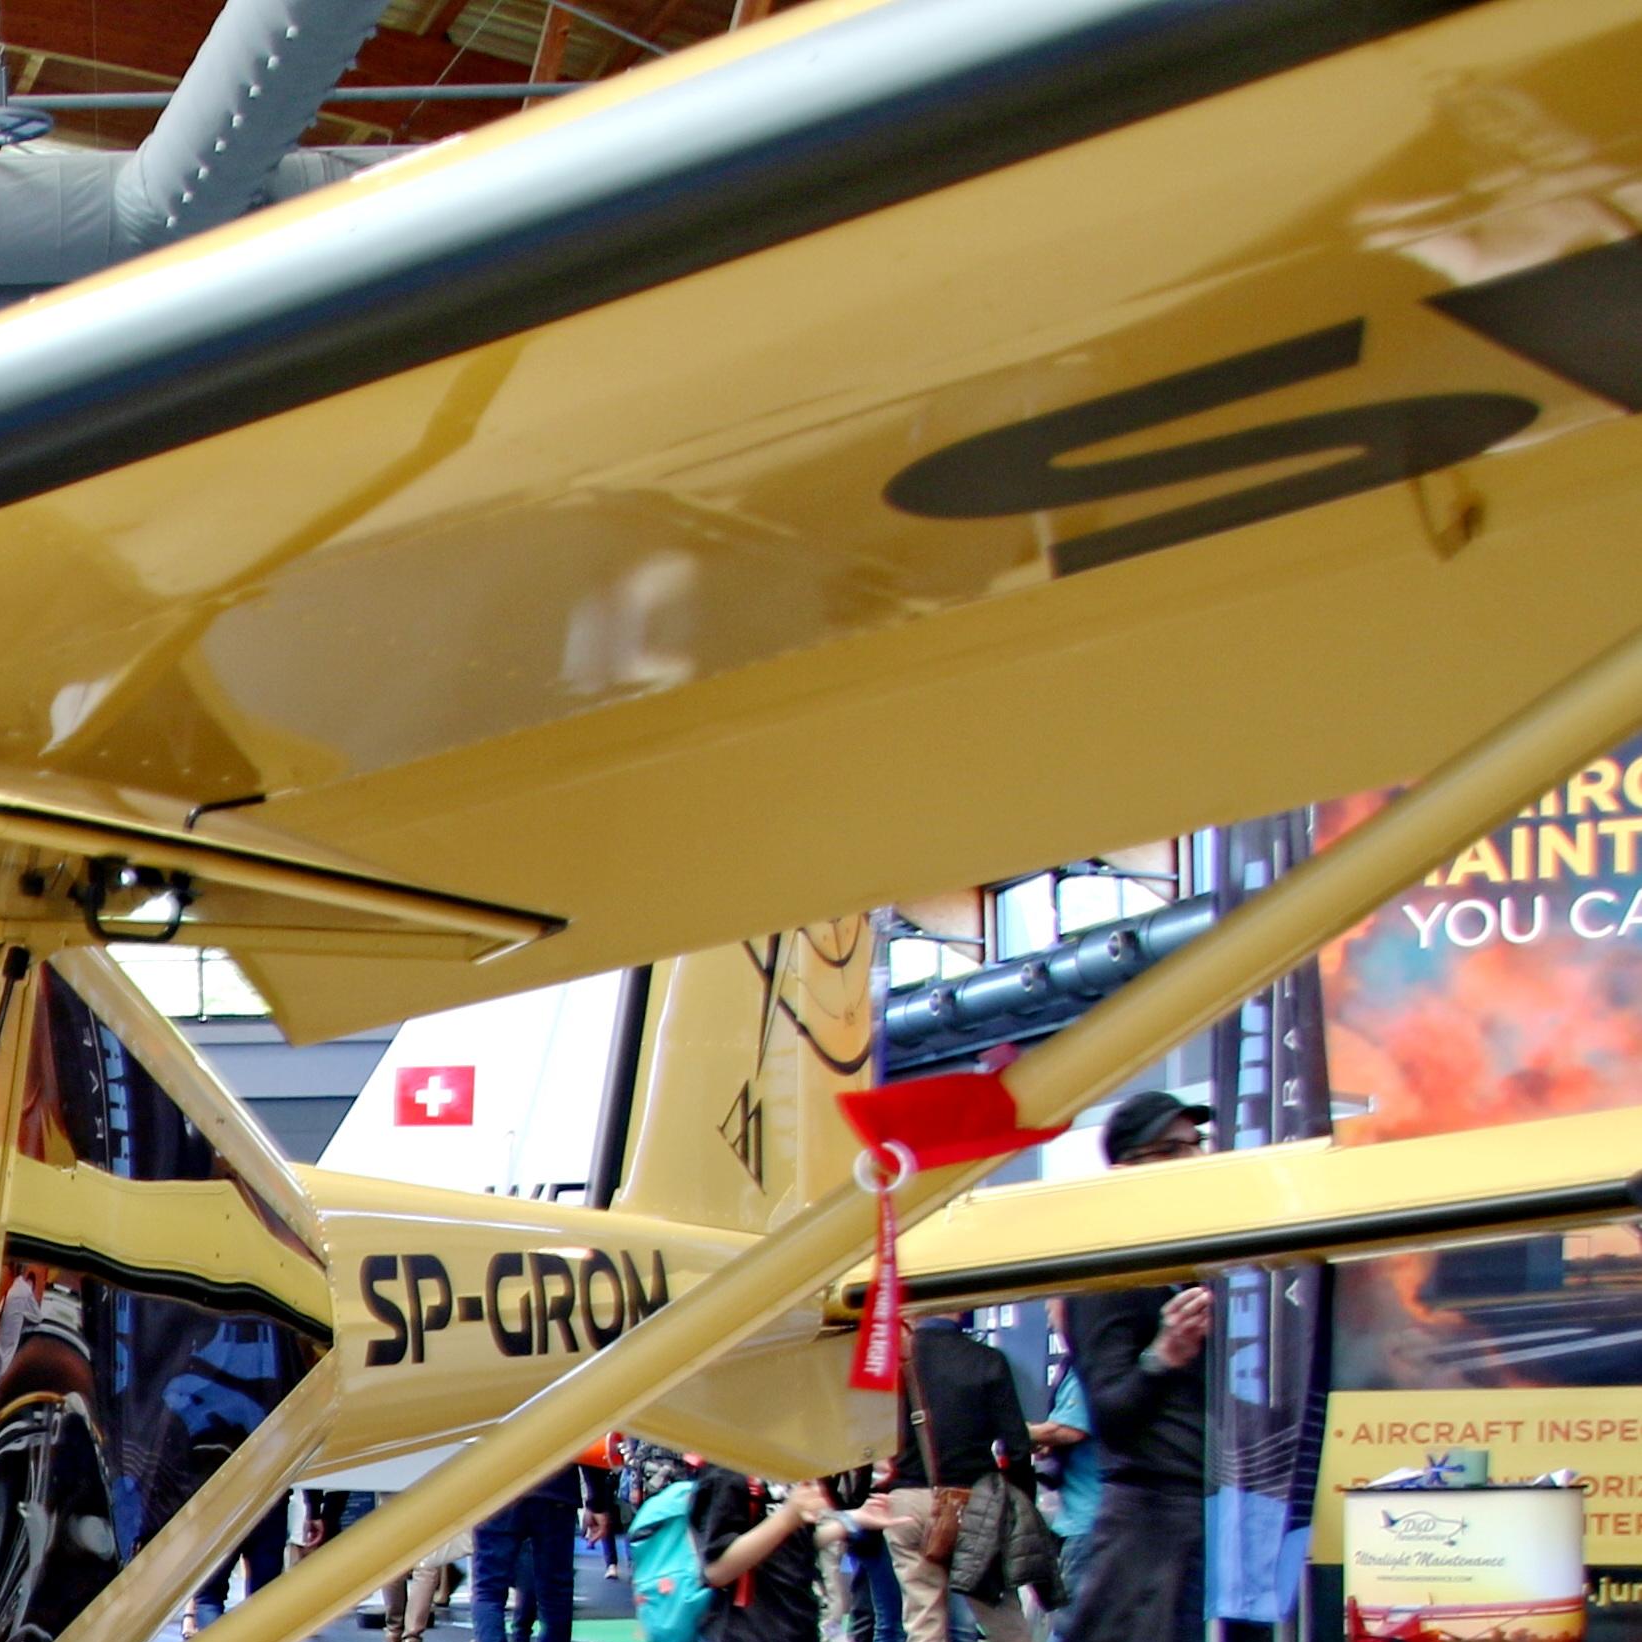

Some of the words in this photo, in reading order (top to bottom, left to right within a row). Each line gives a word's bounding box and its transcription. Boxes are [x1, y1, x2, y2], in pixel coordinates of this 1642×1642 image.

[1423, 816, 1642, 887] AINT
[1402, 893, 1546, 949] YOU
[359, 1248, 669, 1368] SP-GROM
[1352, 1420, 1523, 1444] AIRCRAFT
[1537, 1418, 1642, 1442] INSPE
[1414, 1551, 1506, 1567] Maintenance
